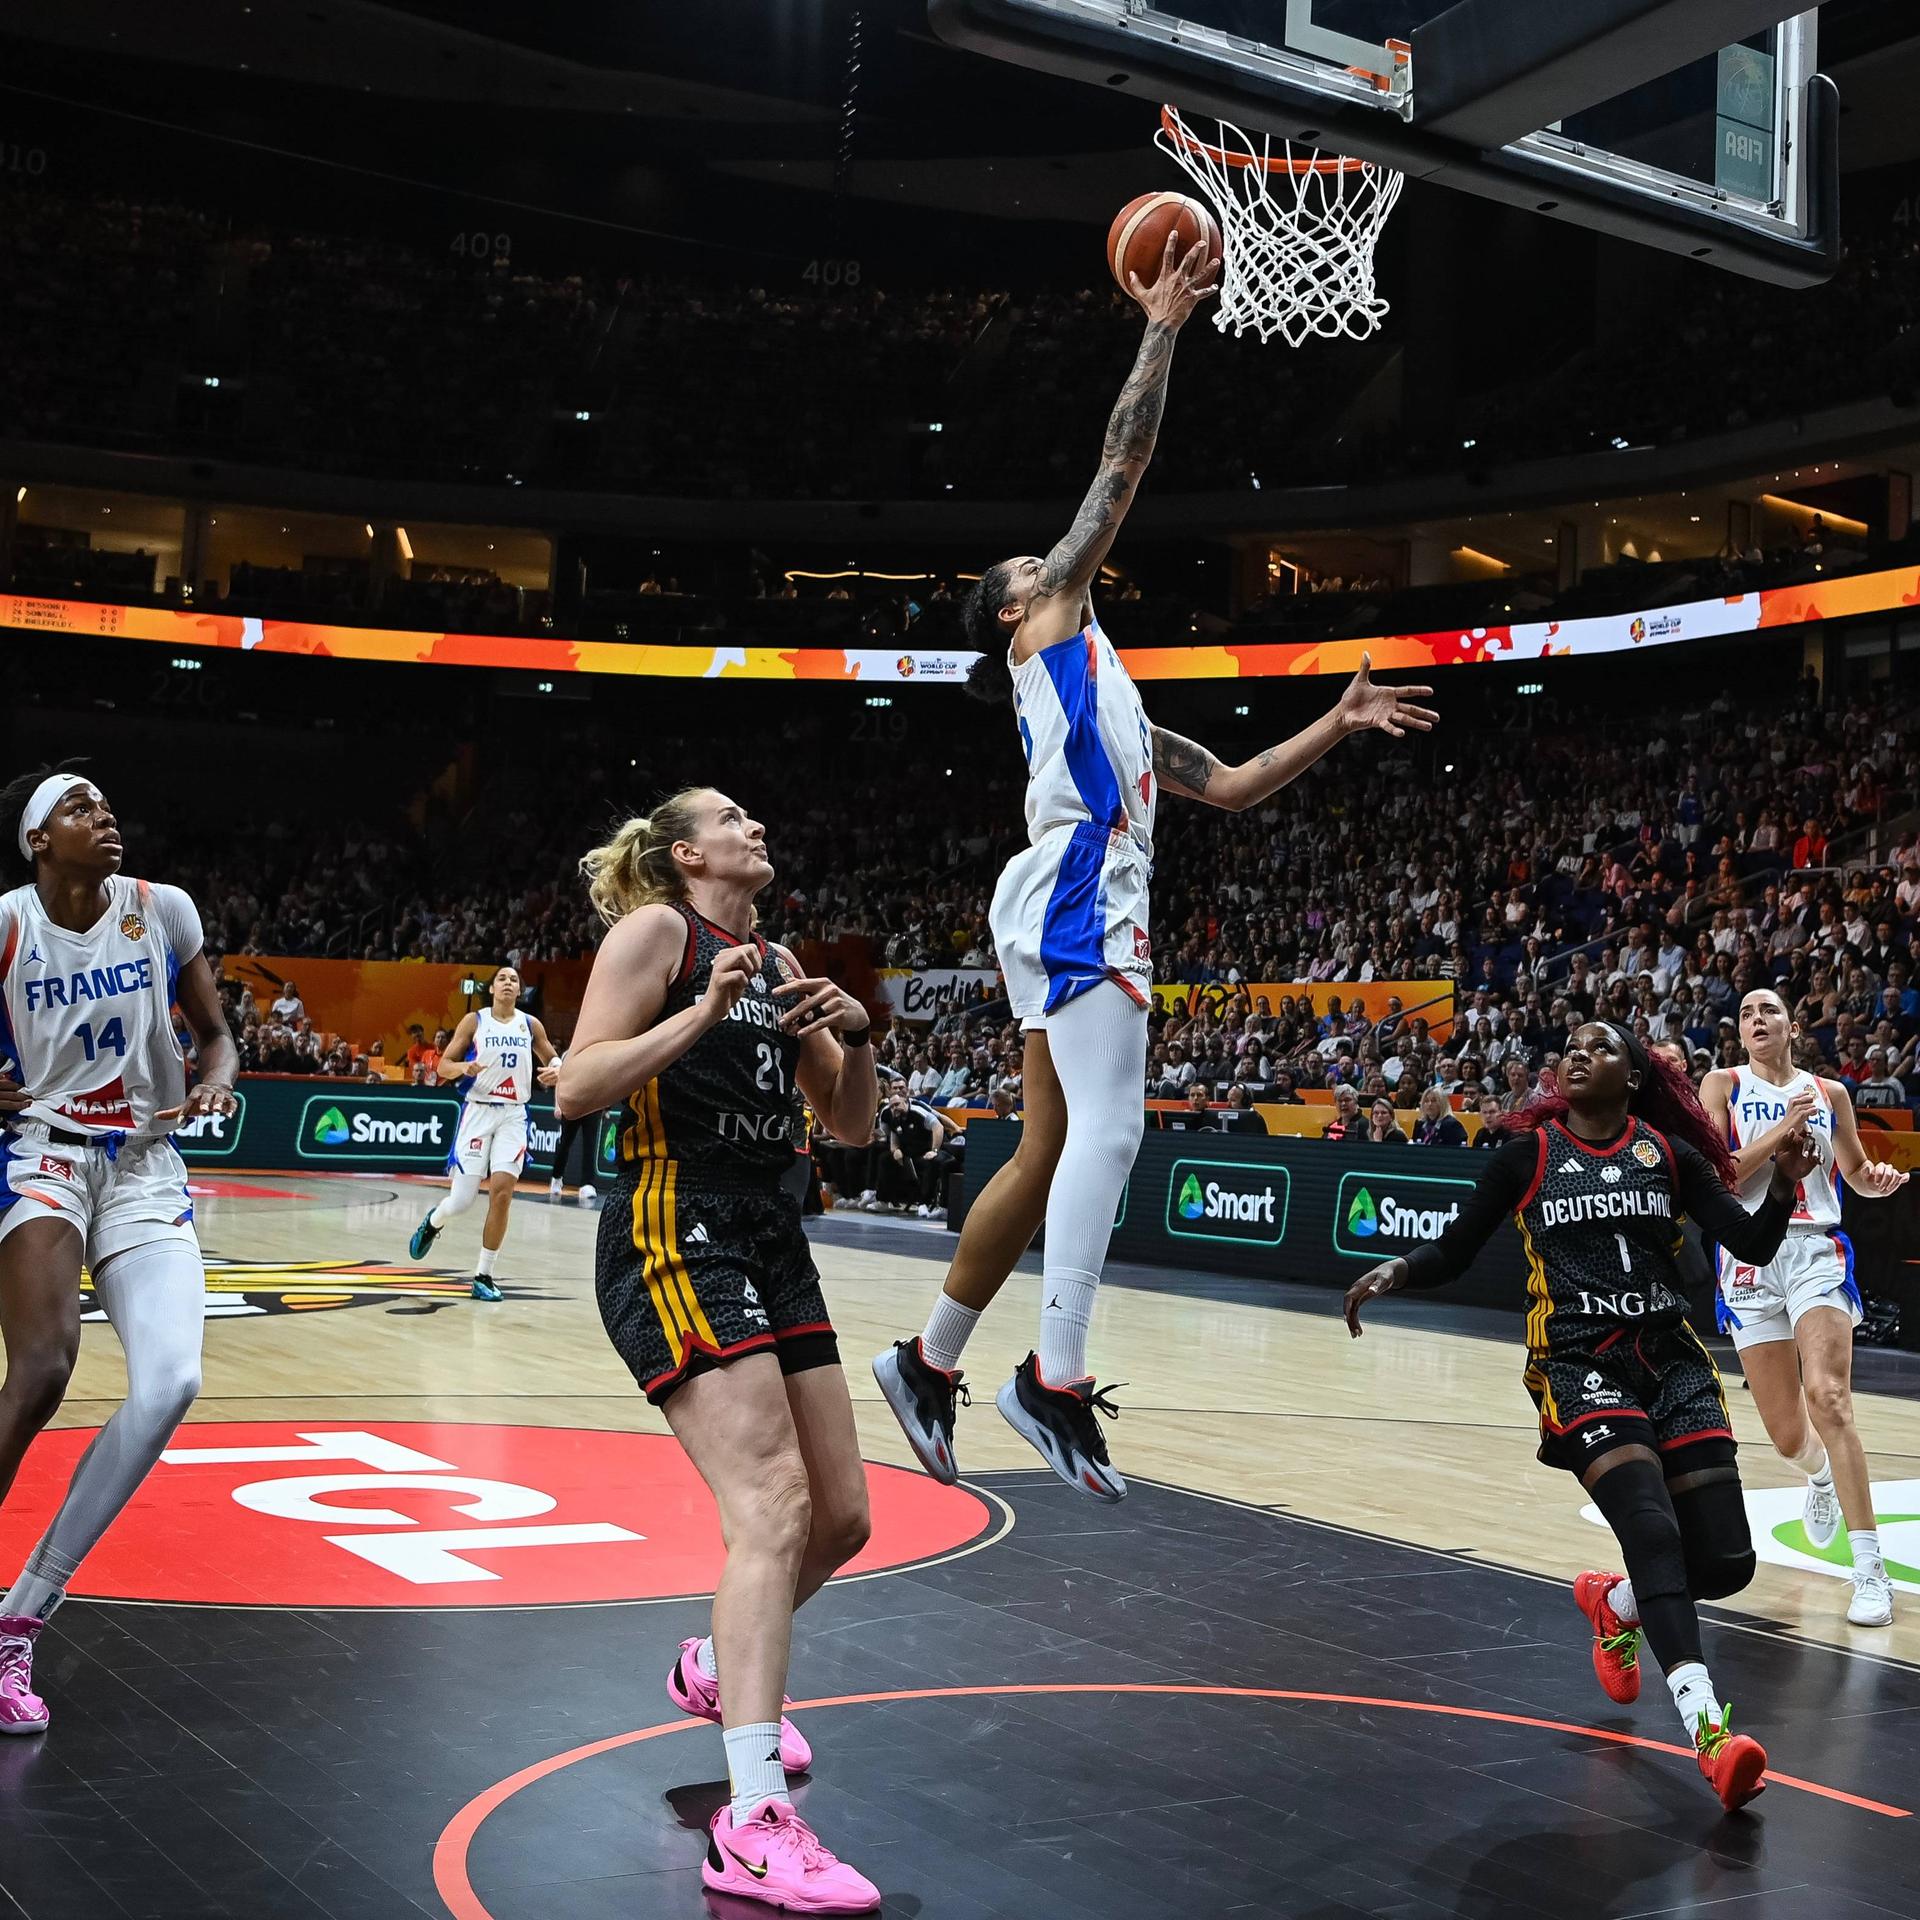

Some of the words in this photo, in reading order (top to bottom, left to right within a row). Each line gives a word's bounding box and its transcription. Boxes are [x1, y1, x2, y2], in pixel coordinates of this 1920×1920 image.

[0, 139, 46, 175] 10
[449, 231, 511, 258] 409
[801, 259, 861, 286] 408
[25, 958, 153, 1012] FRANCE
[904, 974, 984, 1012] Berlin
[74, 1016, 127, 1061] 14
[485, 1036, 528, 1048] FRANCE
[500, 1052, 517, 1068] 13
[756, 1042, 785, 1095] 21
[493, 1086, 517, 1095] MAIF
[65, 1099, 129, 1116] MAIF
[1742, 1102, 1828, 1129] FRAE
[169, 1112, 225, 1138] art
[351, 1112, 443, 1145] Smart
[716, 1112, 785, 1142] ING
[1205, 1181, 1276, 1223] Smart
[1542, 1190, 1672, 1228] DEUTSCHLAND
[1614, 1232, 1632, 1273] 1
[1577, 1291, 1647, 1316] ING
[1582, 1387, 1622, 1400] Domino's
[1594, 1397, 1620, 1405] Pizza
[158, 1431, 648, 1584] TCL
